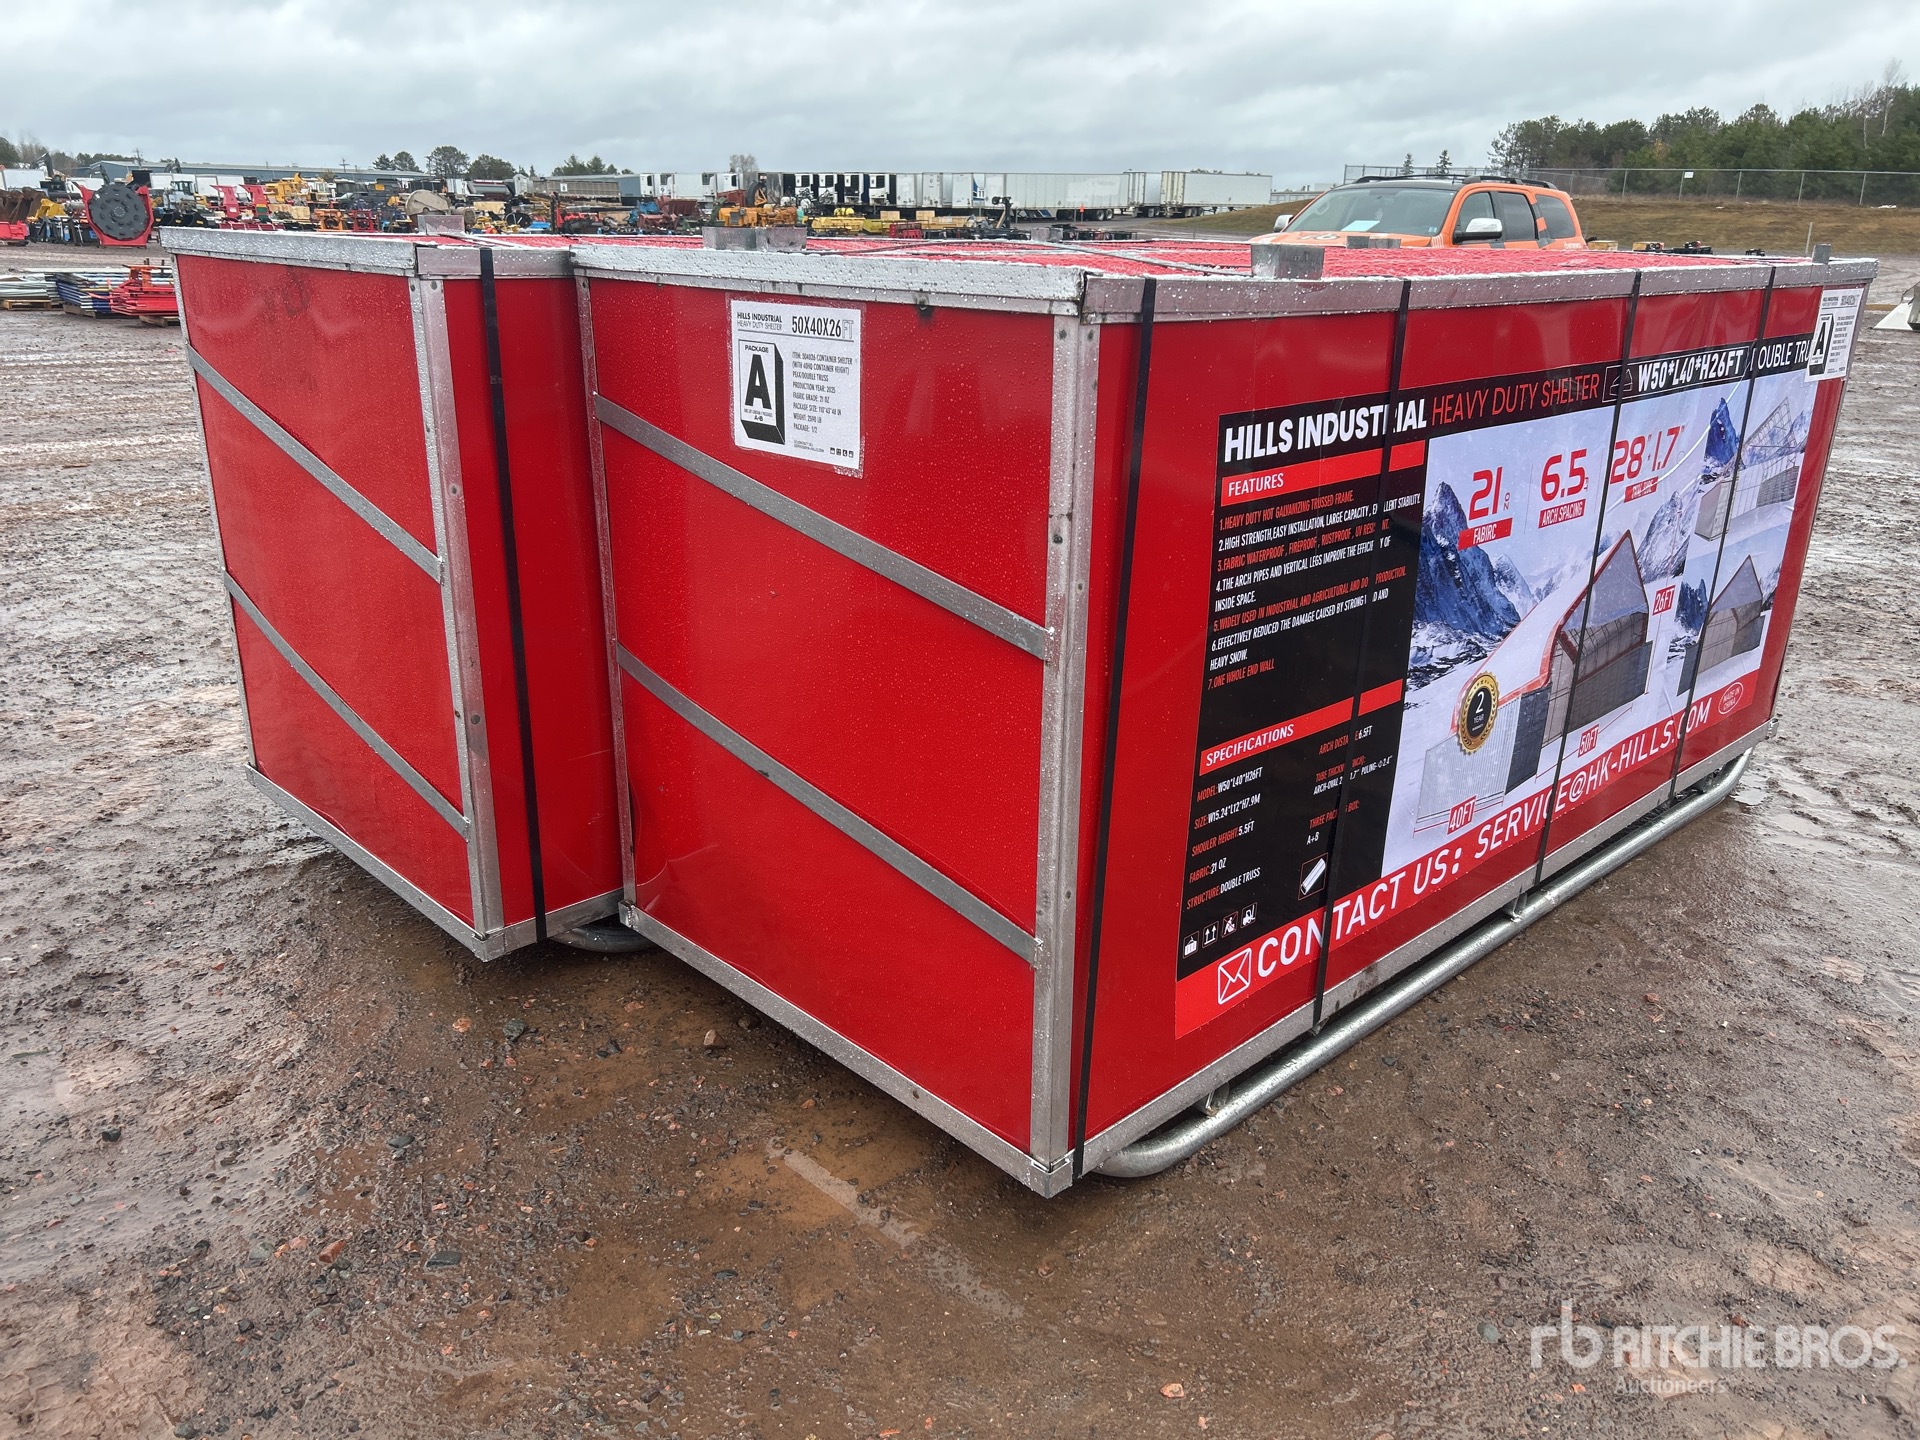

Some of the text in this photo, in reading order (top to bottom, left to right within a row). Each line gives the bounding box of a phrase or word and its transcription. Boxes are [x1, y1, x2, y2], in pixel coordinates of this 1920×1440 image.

[737, 311, 782, 323] HILLS INDUSTRIAL
[765, 321, 782, 331] SHELTER
[744, 344, 769, 353] PACKAGE
[1812, 321, 1827, 356] A
[744, 353, 773, 410] A
[1224, 418, 1294, 463] HILLS
[1431, 388, 1490, 426] HEAVY
[1491, 382, 1539, 416] DUTY
[1540, 373, 1600, 408] SHELTER
[1227, 472, 1284, 498] FEATURES
[1541, 448, 1587, 502] 6.5
[1468, 466, 1503, 521] 21
[1219, 513, 1245, 531] 1.HEAVY
[1245, 510, 1262, 526] DUTY
[1262, 507, 1275, 522] HOT
[1275, 500, 1311, 519] GALVANIZING
[1311, 494, 1334, 510] TRUSSED
[1541, 501, 1583, 527] ARCH SPACING
[1218, 535, 1240, 552] 2.HIGH
[1325, 510, 1344, 526] LARGE
[1472, 523, 1497, 545] FABIRC
[1217, 554, 1246, 572] 3.FABRIC
[1354, 524, 1364, 538] UV
[1215, 576, 1235, 593] 4.THE
[1234, 572, 1252, 588] ARCH
[1252, 568, 1270, 583] PIPES
[1269, 564, 1282, 579] AND
[1283, 558, 1308, 576] VERTICAL
[1309, 554, 1323, 568] LEGS
[1323, 547, 1347, 565] IMPROVE
[1346, 544, 1357, 558] THE
[1383, 535, 1391, 548] OF
[1214, 590, 1257, 613] INSIDE SPACE.
[1241, 609, 1257, 624] USED
[1257, 606, 1266, 619] IN
[1265, 597, 1299, 617] INDUSTRIAL
[1299, 593, 1312, 607] AND
[1311, 582, 1349, 604] AGRICULTURAL
[1349, 579, 1360, 592] AND
[1653, 587, 1675, 613] 26FT
[1211, 628, 1253, 652] 6.EFFECTIVELY
[1252, 621, 1280, 640] REDUCED
[1279, 617, 1292, 631] THE
[1291, 610, 1316, 628] DAMAGE
[1315, 604, 1336, 620] CAUSED
[1336, 601, 1345, 614] BY
[1344, 595, 1364, 611] STRONG
[1377, 587, 1389, 601] AND
[1209, 648, 1248, 671] HEAVY SNOW.
[1226, 666, 1247, 683] WHOLE
[1247, 663, 1259, 677] END
[1259, 658, 1275, 673] WALL
[1475, 691, 1485, 714] 2
[1205, 723, 1295, 767] SPECIFICATIONS
[1318, 741, 1334, 755] ARCH
[1579, 726, 1599, 756] 50FT
[1315, 769, 1328, 783] TUBE
[1309, 813, 1326, 829] THREE
[1449, 799, 1476, 830] 40FT
[1191, 836, 1218, 857] SHOULER
[1306, 831, 1320, 846] A+B
[1218, 857, 1227, 870] OZ
[1242, 866, 1261, 884] TRUSS
[1257, 870, 1407, 978] CONTACT
[1413, 847, 1463, 896] US:
